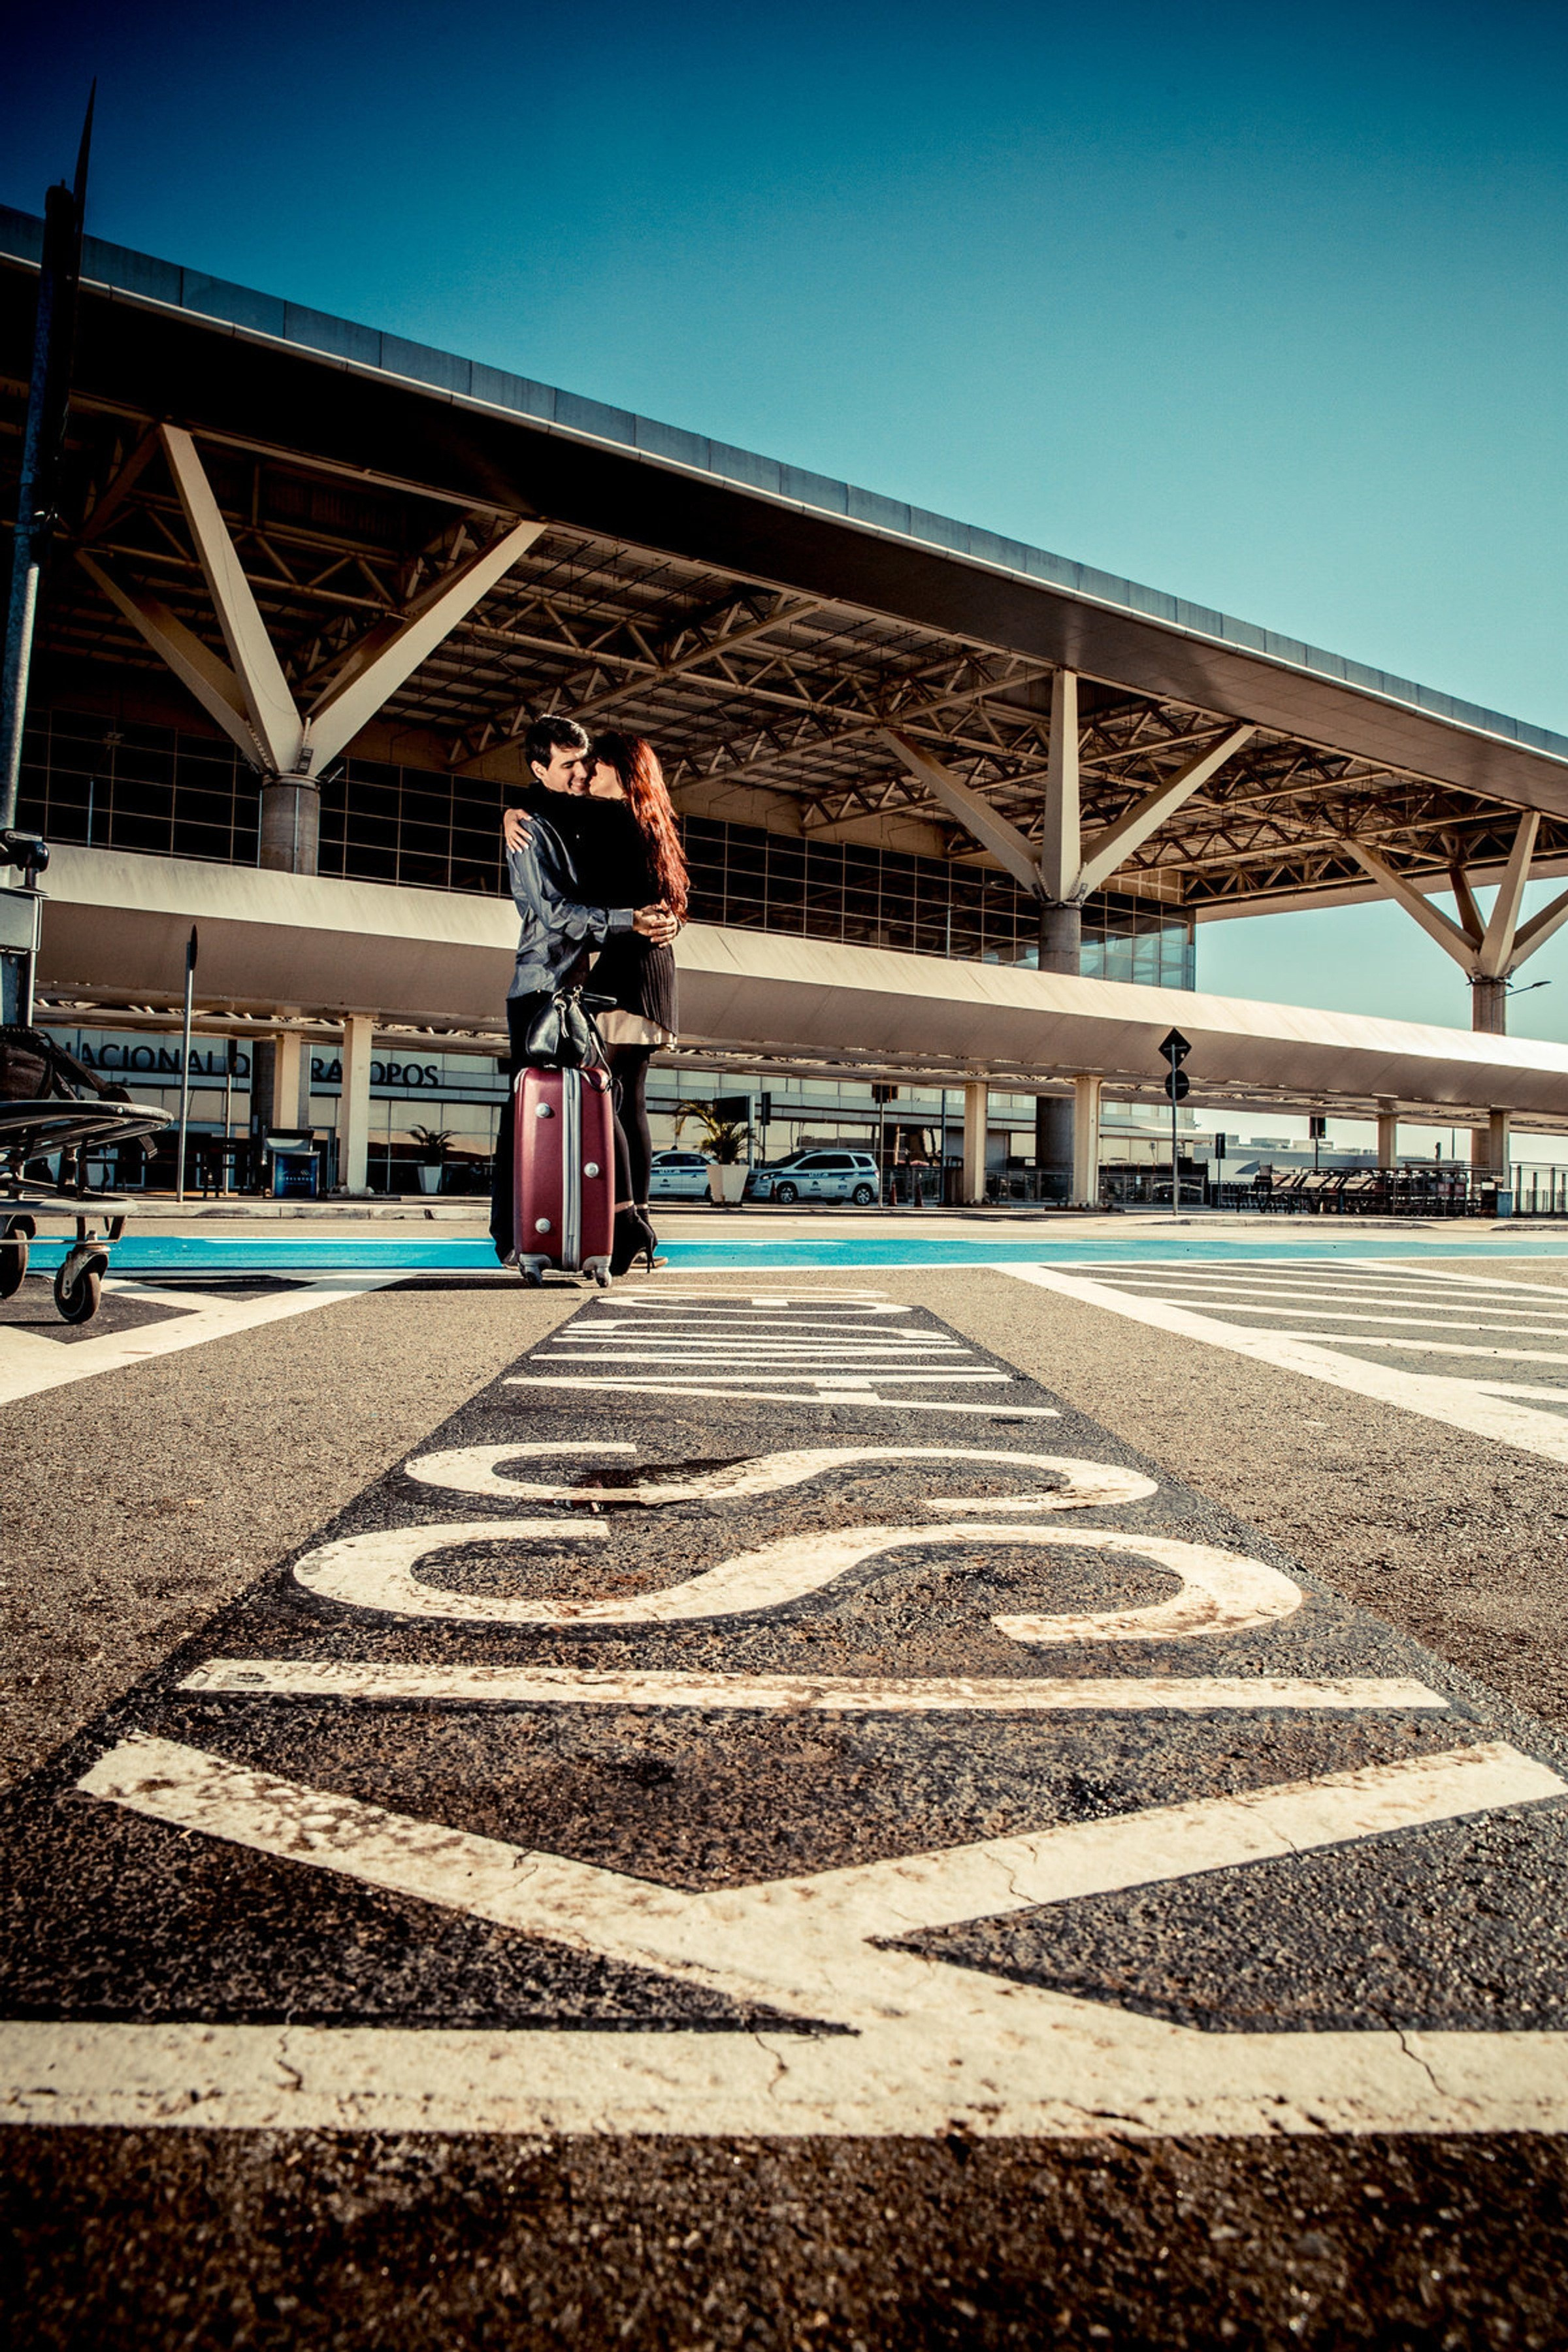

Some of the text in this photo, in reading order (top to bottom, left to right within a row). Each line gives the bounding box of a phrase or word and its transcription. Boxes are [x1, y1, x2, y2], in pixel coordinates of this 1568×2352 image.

[65, 1041, 216, 1073] ACIONAL
[311, 1057, 439, 1086] RAOPOS
[0, 1284, 1568, 2138] KISS AND GO
